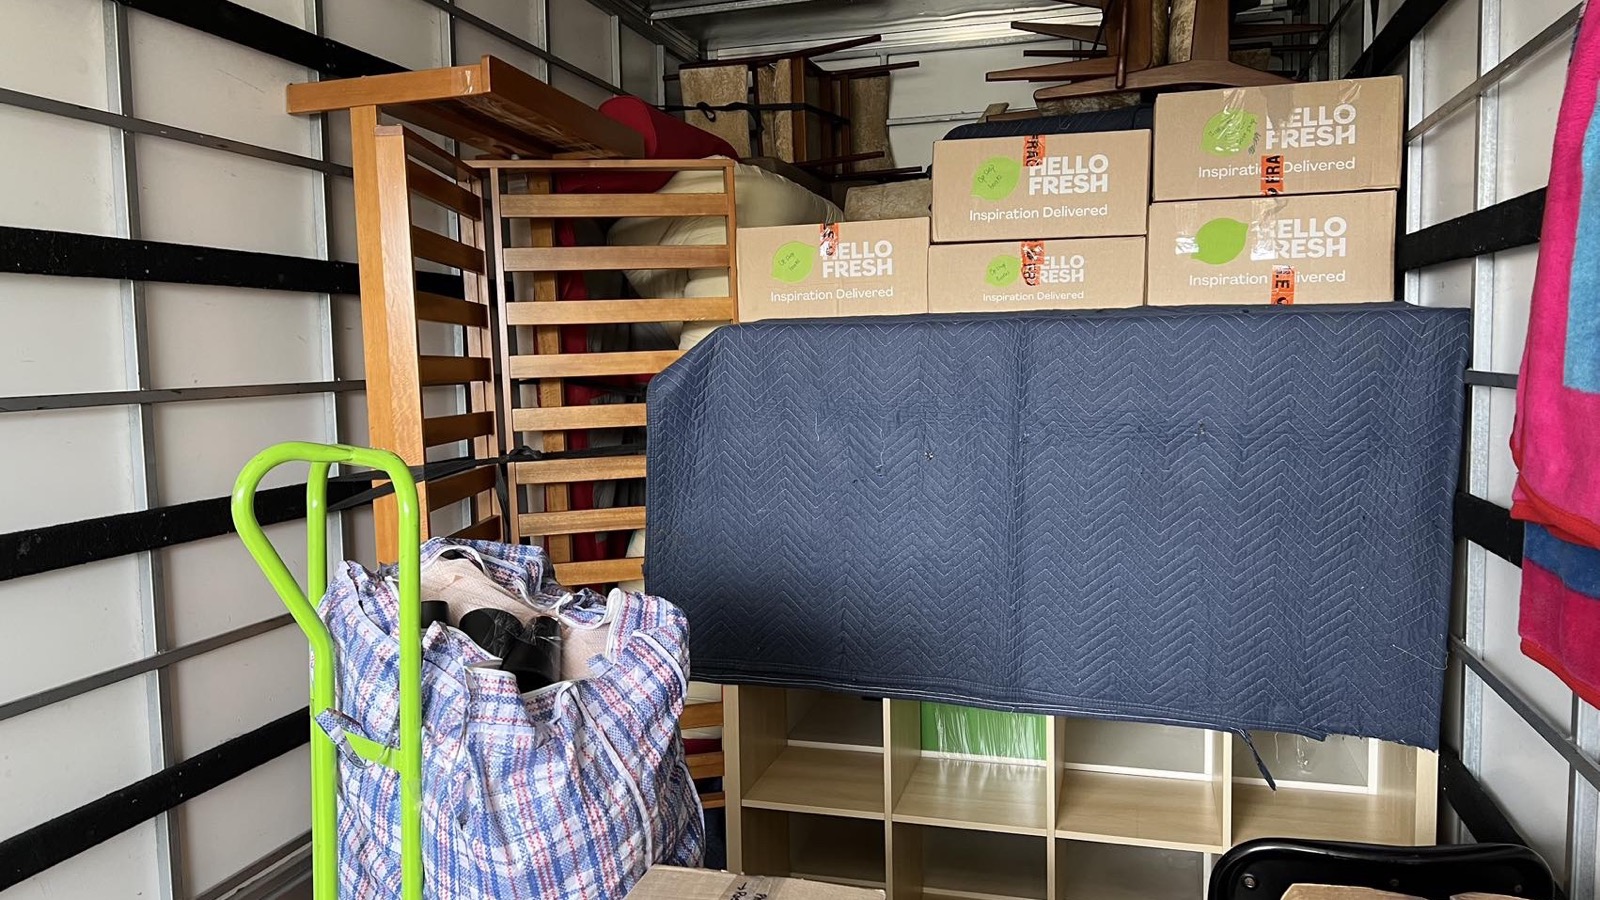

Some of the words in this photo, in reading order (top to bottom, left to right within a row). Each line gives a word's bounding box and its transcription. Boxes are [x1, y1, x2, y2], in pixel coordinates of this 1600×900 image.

[1266, 104, 1357, 129] ELLO
[1266, 125, 1356, 150] FRESH
[1198, 163, 1261, 180] Inspirati
[1283, 156, 1356, 174] Delivered
[1029, 174, 1109, 196] FRESH
[969, 207, 1040, 223] Inspiration
[1043, 204, 1108, 218] Delivered
[1273, 237, 1346, 259] RESH
[823, 258, 893, 278] FRESH
[1041, 255, 1085, 270] ELLO
[1041, 269, 1085, 284] RESH
[1189, 273, 1268, 288] Inspiration
[770, 290, 833, 304] Inspiration
[836, 286, 894, 299] Delivered
[983, 292, 1035, 303] Inspiration
[1036, 291, 1085, 300] Delivered
